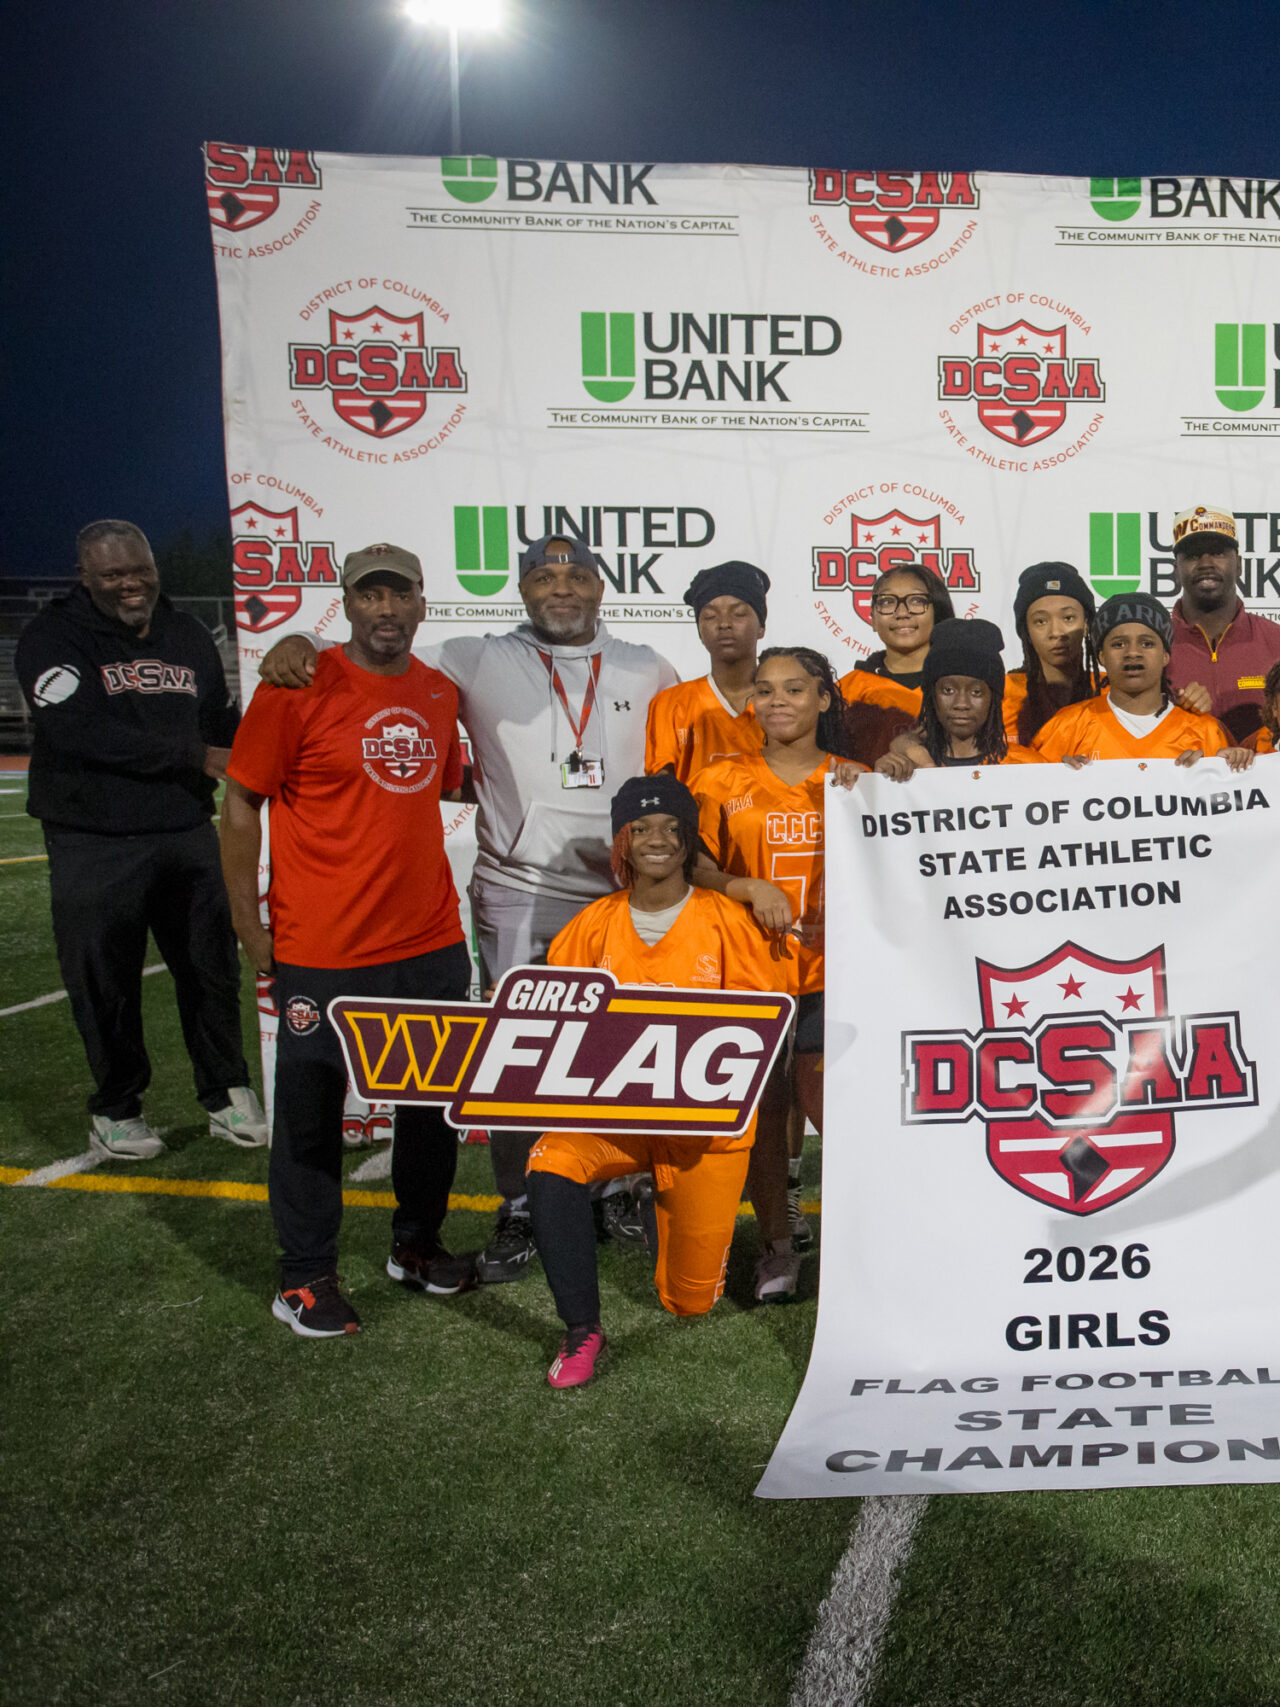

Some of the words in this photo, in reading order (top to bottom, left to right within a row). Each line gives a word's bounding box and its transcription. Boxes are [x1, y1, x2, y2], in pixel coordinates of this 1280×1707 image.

[205, 141, 323, 190] SAA
[506, 159, 659, 206] BANK
[808, 168, 980, 212] DCSAA
[248, 199, 323, 258] ASSOCIATION
[809, 214, 839, 252] STATE
[837, 251, 900, 279] ATHLETIC
[904, 219, 979, 278] ASSOCIATION
[299, 279, 353, 321] DISTRICT
[358, 278, 378, 289] OF
[382, 279, 451, 324] COLUMBIA
[949, 295, 1002, 335] DISTRICT
[1006, 293, 1025, 304] OF
[1029, 294, 1092, 336] COLUMBIA
[642, 312, 842, 357] UNITED
[288, 339, 468, 397] DCSAA
[643, 358, 791, 402] BANK
[937, 352, 1106, 407] DCSAA
[291, 399, 324, 438] STATE
[321, 436, 388, 465] ATHLETIC
[393, 403, 467, 463] ASSOCIATION
[938, 409, 968, 447] STATE
[966, 445, 1028, 472] ATHLETIC
[1032, 413, 1105, 471] ASSOCIATION
[231, 473, 252, 485] OF
[256, 474, 325, 519] COLUMBIA
[823, 485, 875, 526] DISTRICT
[879, 482, 898, 493] OF
[903, 483, 965, 525] COLUMBIA
[515, 505, 715, 548] UNITED
[233, 535, 342, 591] SAA
[455, 607, 526, 618] COMMUNIT
[814, 600, 842, 638] STATE
[99, 658, 198, 698] DCSAA
[362, 735, 437, 761] DCSAA
[766, 811, 823, 845] CCC
[861, 803, 1013, 838] DISTRICT
[1024, 800, 1070, 826] OF
[1082, 787, 1270, 822] COLUMBIA
[918, 846, 1027, 877] STATE
[1037, 833, 1213, 869] ATHLETIC
[943, 880, 1182, 920] ASSOCIATION
[506, 979, 604, 1014] GIRLS
[469, 1018, 766, 1102] FLAG
[900, 1010, 1260, 1131] DCSAA
[1023, 1242, 1152, 1284] 2026
[1004, 1309, 1171, 1352] GIRLS
[849, 1376, 1000, 1397] FLAG
[954, 1403, 1215, 1432] STATE
